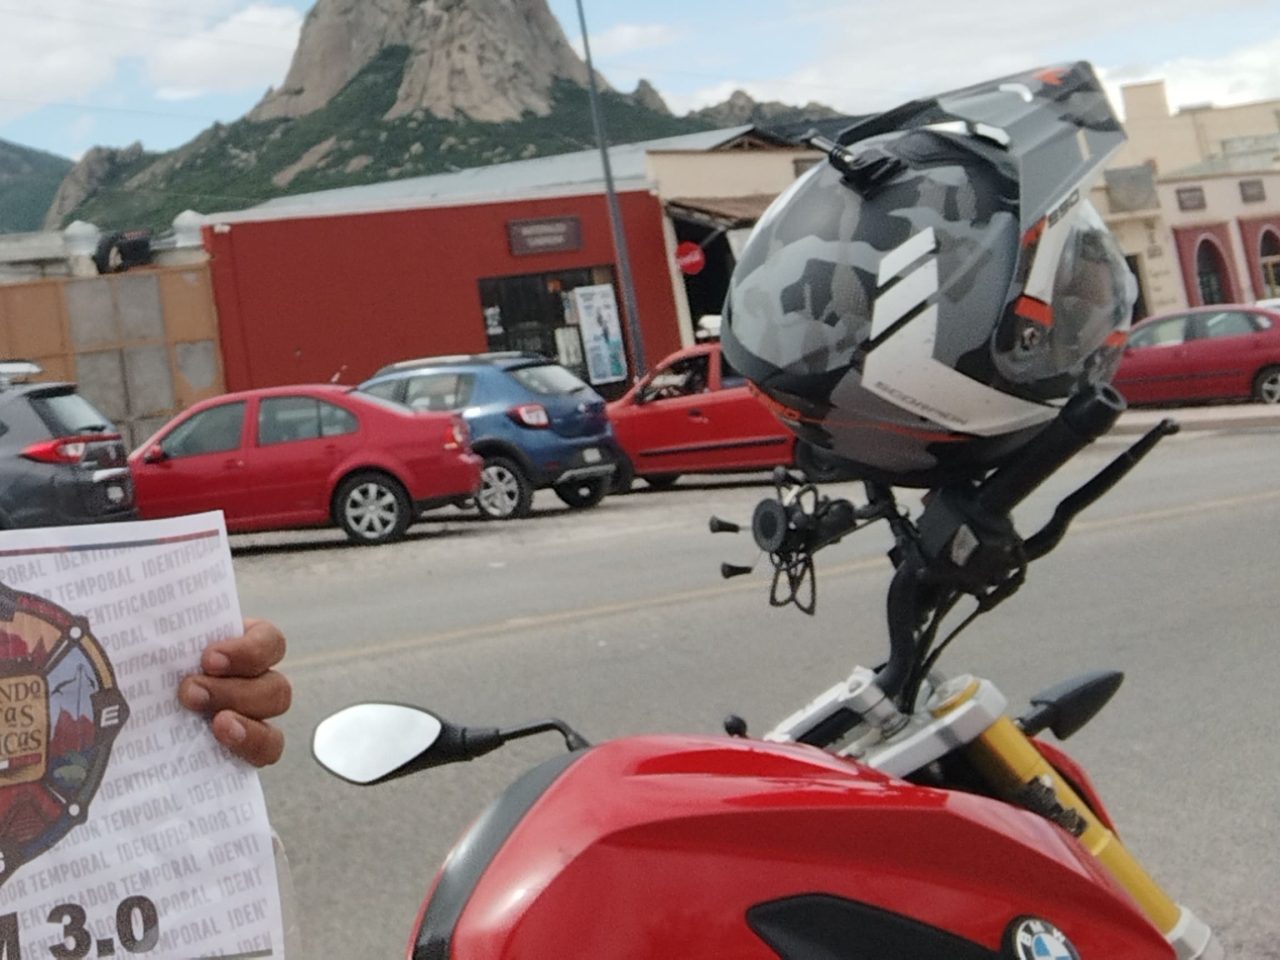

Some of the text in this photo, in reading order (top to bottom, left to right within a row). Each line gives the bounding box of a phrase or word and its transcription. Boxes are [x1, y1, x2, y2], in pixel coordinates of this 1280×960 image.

[99, 705, 120, 728] E
[102, 793, 183, 835] TEMPORAL
[29, 851, 112, 893] TEMPORAL
[116, 808, 229, 864] IDENTIFICADOR
[120, 854, 202, 895] TEMPORAL
[45, 894, 160, 960] 3.0
[1018, 920, 1067, 948] BMW
